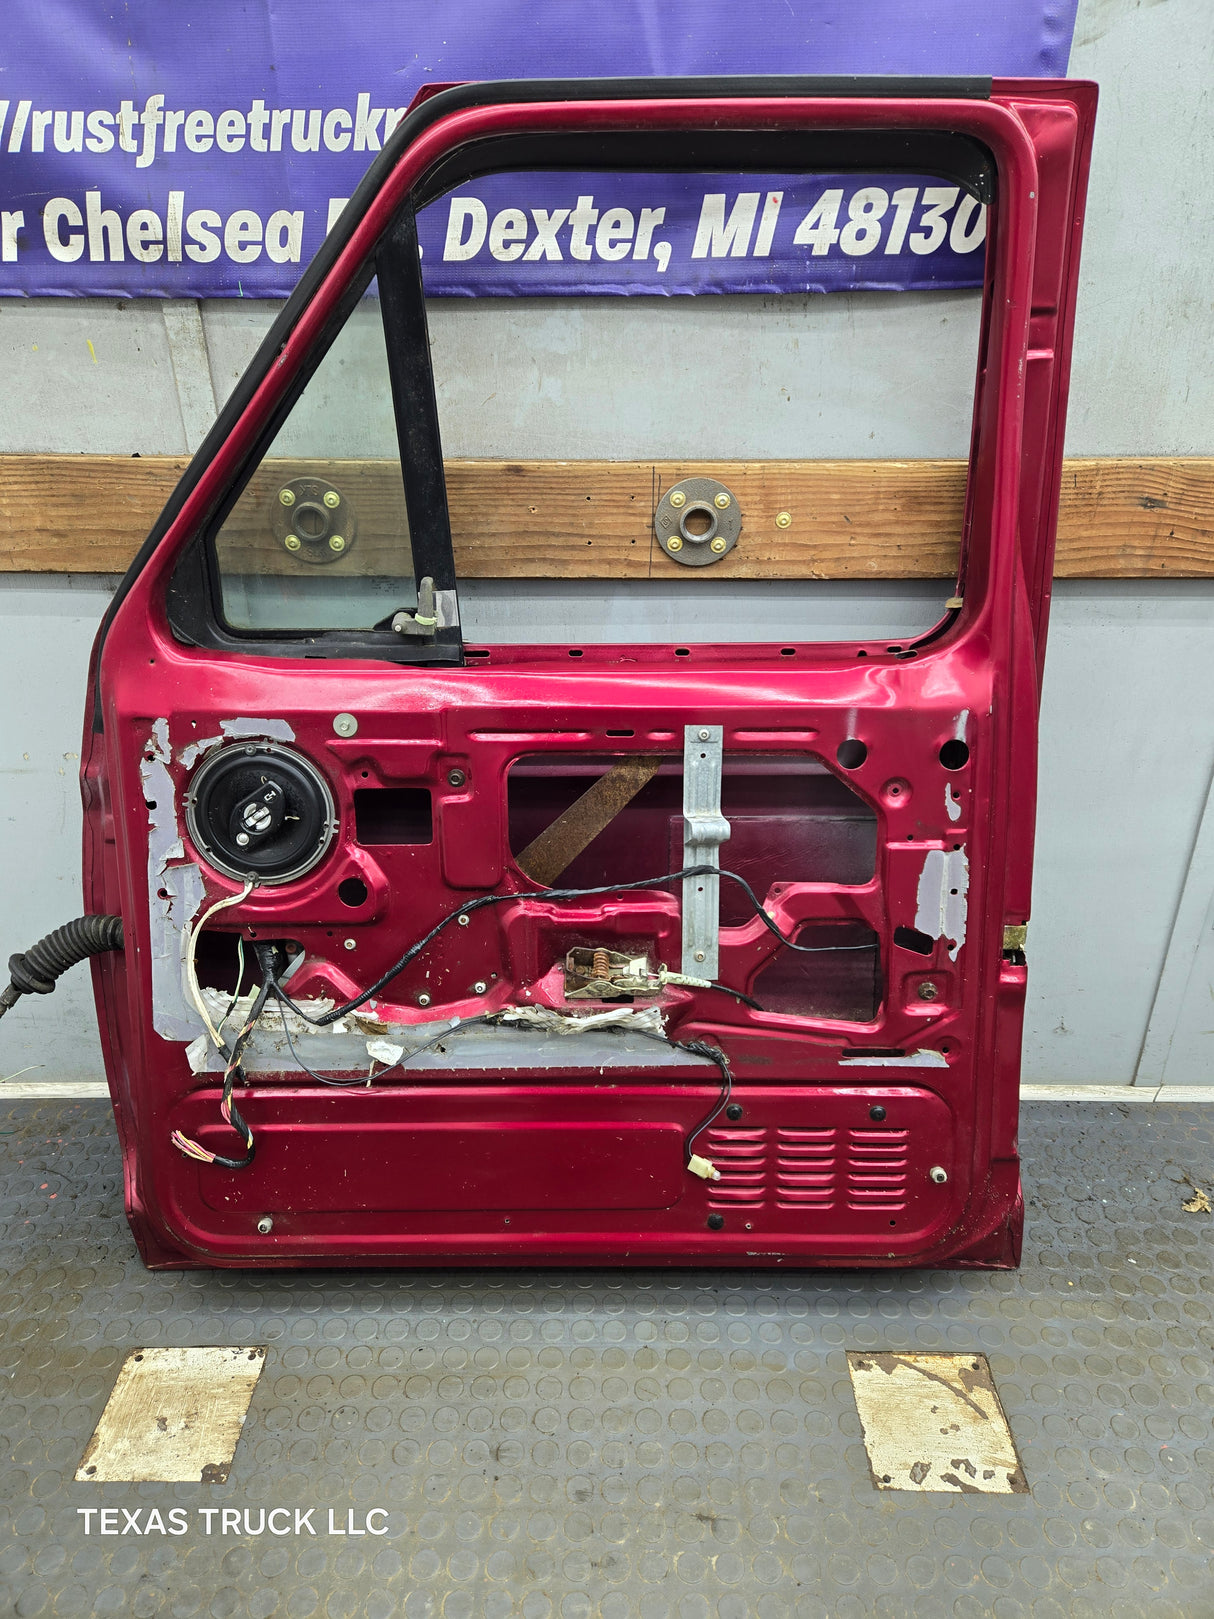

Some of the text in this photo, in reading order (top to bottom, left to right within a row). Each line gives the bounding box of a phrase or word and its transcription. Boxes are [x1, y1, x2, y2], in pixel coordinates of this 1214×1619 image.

[43, 190, 304, 263] Chelsea
[443, 194, 672, 273] Dexter,
[691, 191, 784, 260] MI
[793, 187, 987, 256] 48130
